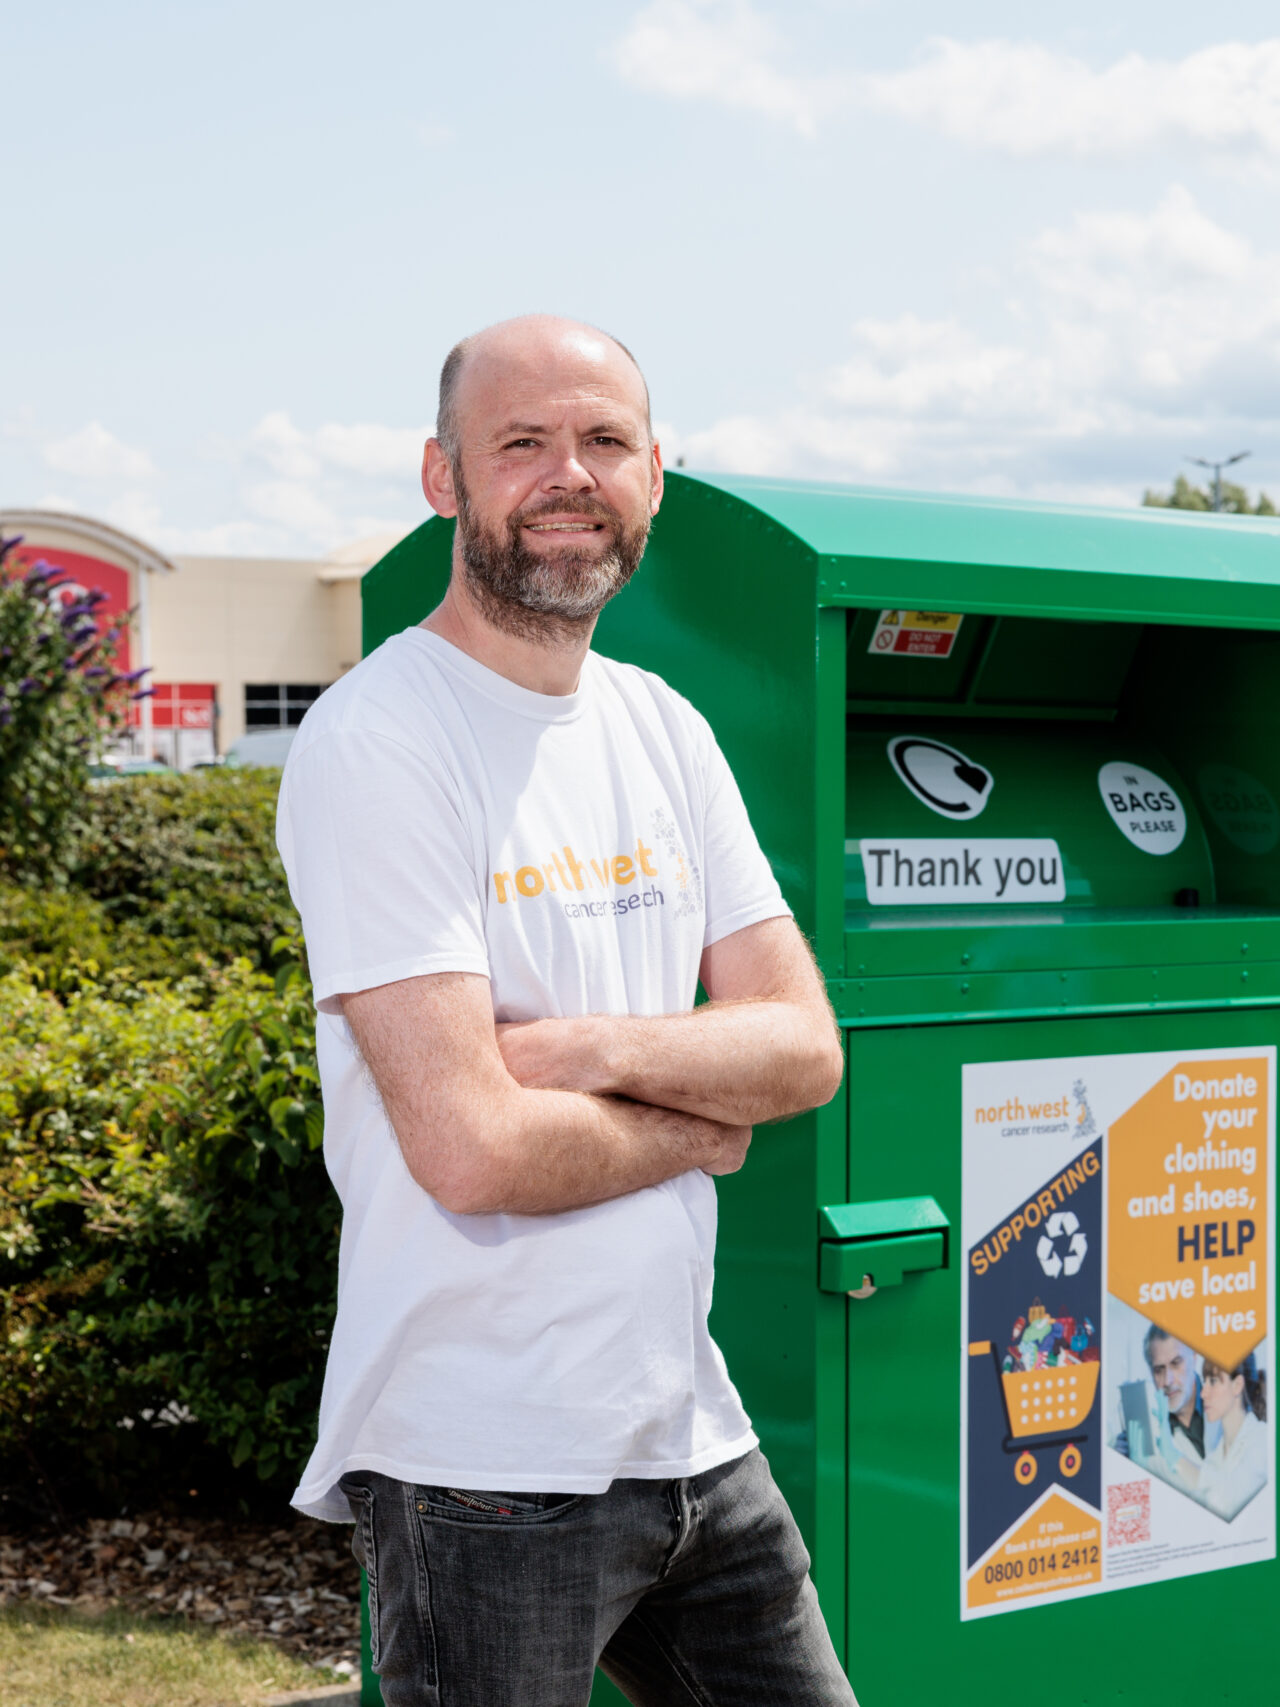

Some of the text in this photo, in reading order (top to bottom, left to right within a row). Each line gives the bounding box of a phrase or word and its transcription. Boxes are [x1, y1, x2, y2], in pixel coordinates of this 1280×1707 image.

[1123, 775, 1139, 786] IN
[1108, 791, 1176, 813] BAGS
[1129, 820, 1177, 833] PLEASE
[868, 848, 1057, 897] Thank you
[1174, 1073, 1257, 1101] Donate
[975, 1096, 1070, 1124] north west
[1202, 1106, 1258, 1138] your
[1001, 1121, 1069, 1138] cancer research
[1164, 1139, 1256, 1175] clothing
[970, 1150, 1101, 1276] SUPPORTING
[1128, 1181, 1256, 1218] and shoes,
[1177, 1219, 1256, 1263] HELP
[1139, 1260, 1256, 1304] save local
[1204, 1305, 1256, 1336] lives
[985, 1559, 1023, 1584] 0800
[1028, 1553, 1056, 1576] 014
[1062, 1545, 1099, 1569] 2412
